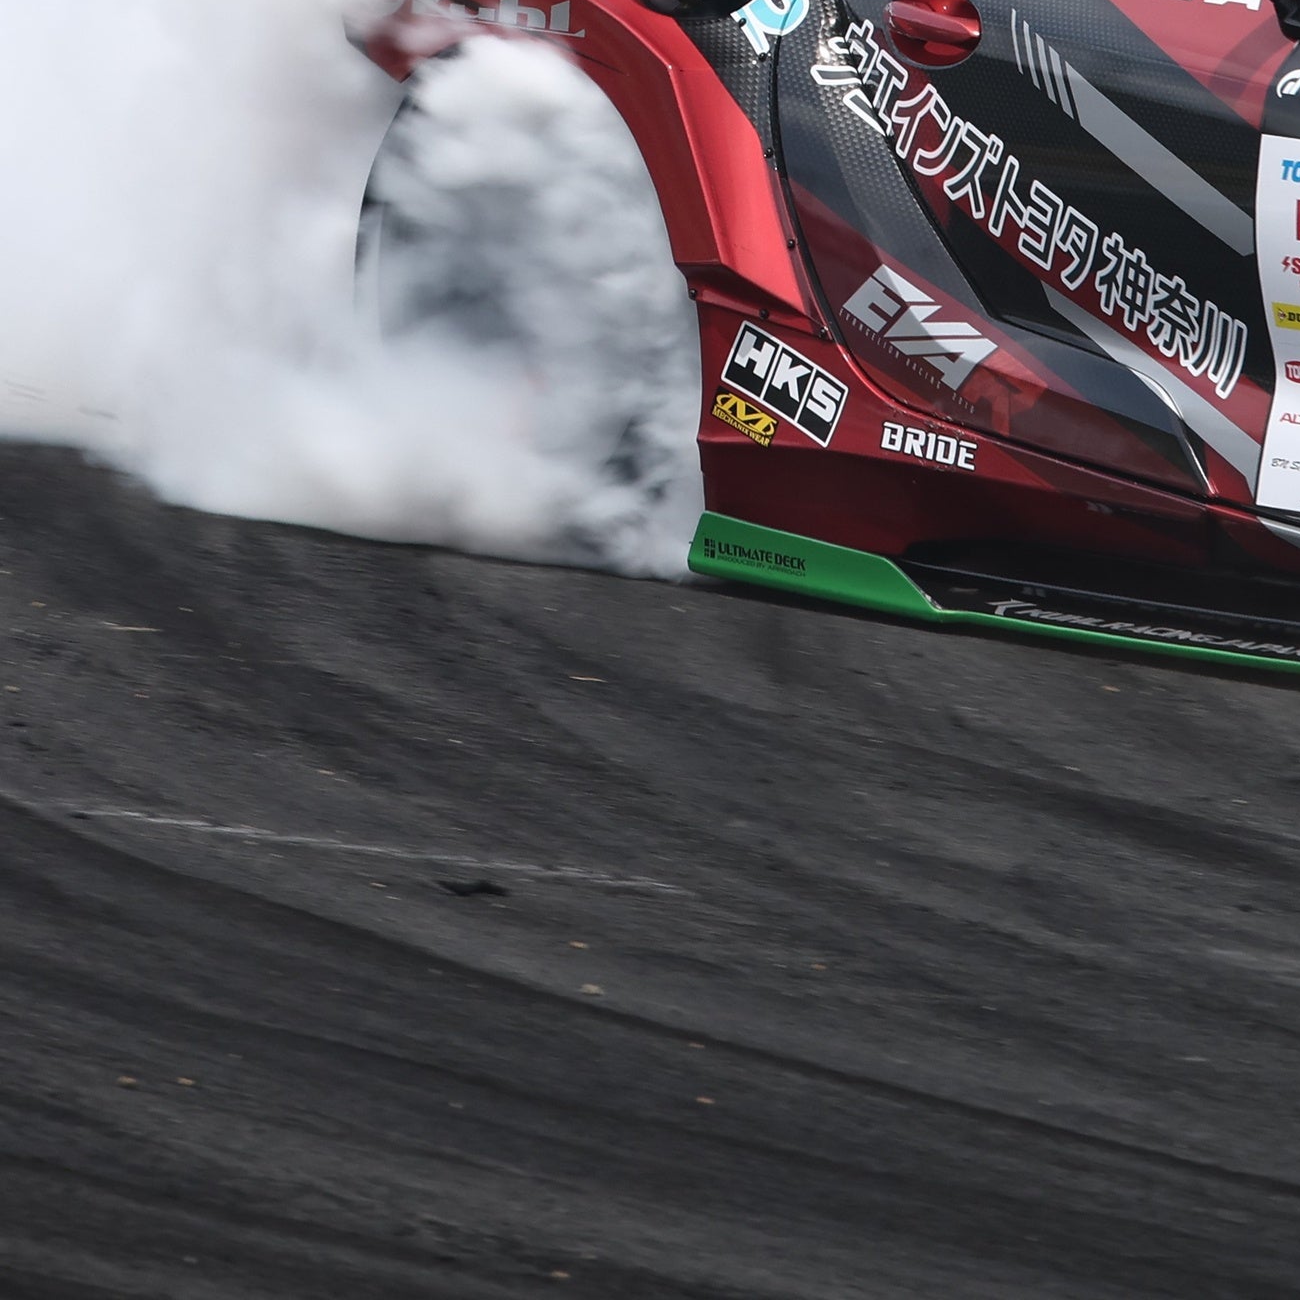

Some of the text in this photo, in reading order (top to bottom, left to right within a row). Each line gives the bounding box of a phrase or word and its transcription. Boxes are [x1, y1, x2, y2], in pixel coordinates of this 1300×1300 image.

[733, 330, 842, 423] HKS
[712, 404, 772, 448] MECHANIX WEAR
[880, 421, 978, 471] BRIDE
[717, 541, 807, 571] ULTIMATE DECK
